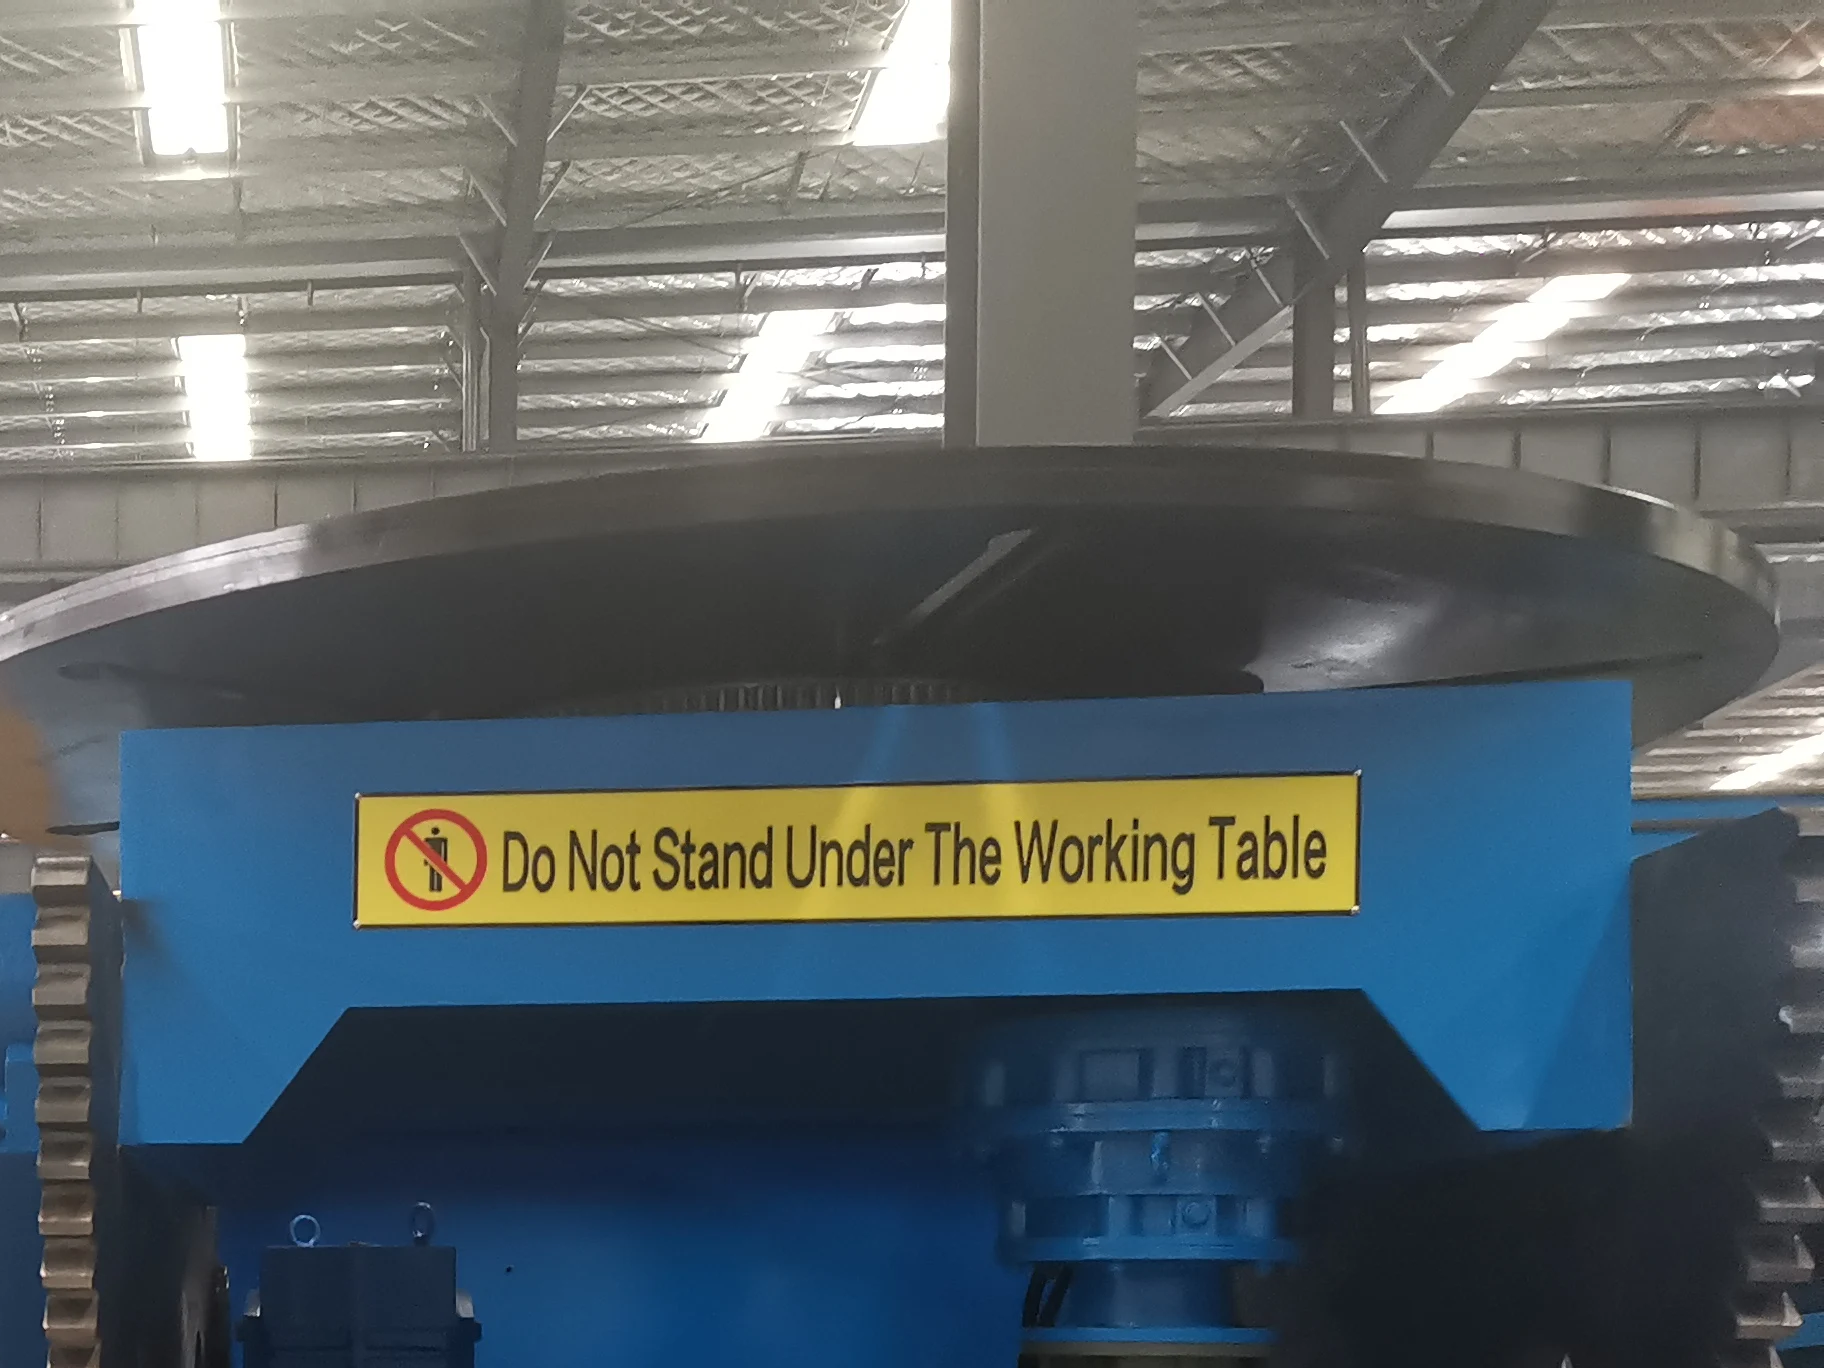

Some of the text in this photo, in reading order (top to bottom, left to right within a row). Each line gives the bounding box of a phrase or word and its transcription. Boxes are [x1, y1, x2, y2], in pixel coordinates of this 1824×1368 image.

[501, 814, 1327, 897] Do Not Stand Under The Working Table
